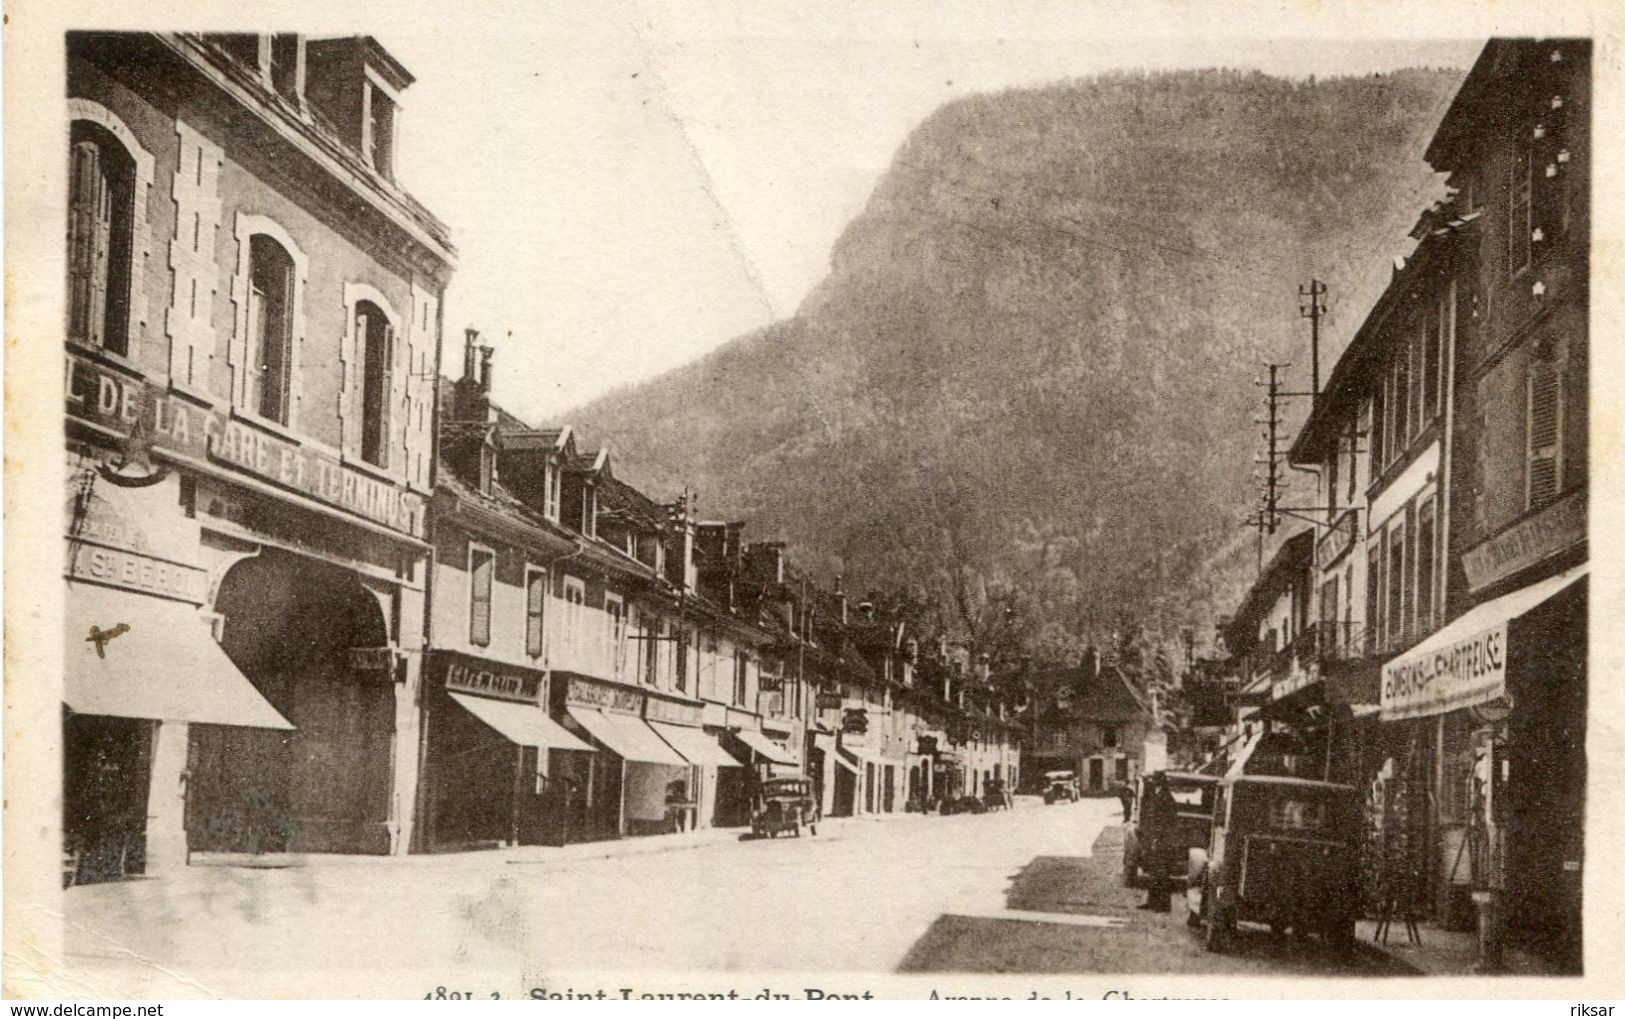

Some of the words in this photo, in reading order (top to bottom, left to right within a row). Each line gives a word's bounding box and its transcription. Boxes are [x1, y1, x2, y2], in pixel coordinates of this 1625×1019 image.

[98, 375, 140, 424] DE
[155, 397, 190, 445] LA
[204, 413, 272, 476] GARE
[281, 448, 307, 485] ET
[317, 456, 413, 530] TERMINUS
[1434, 631, 1503, 681] CHARTREUSE
